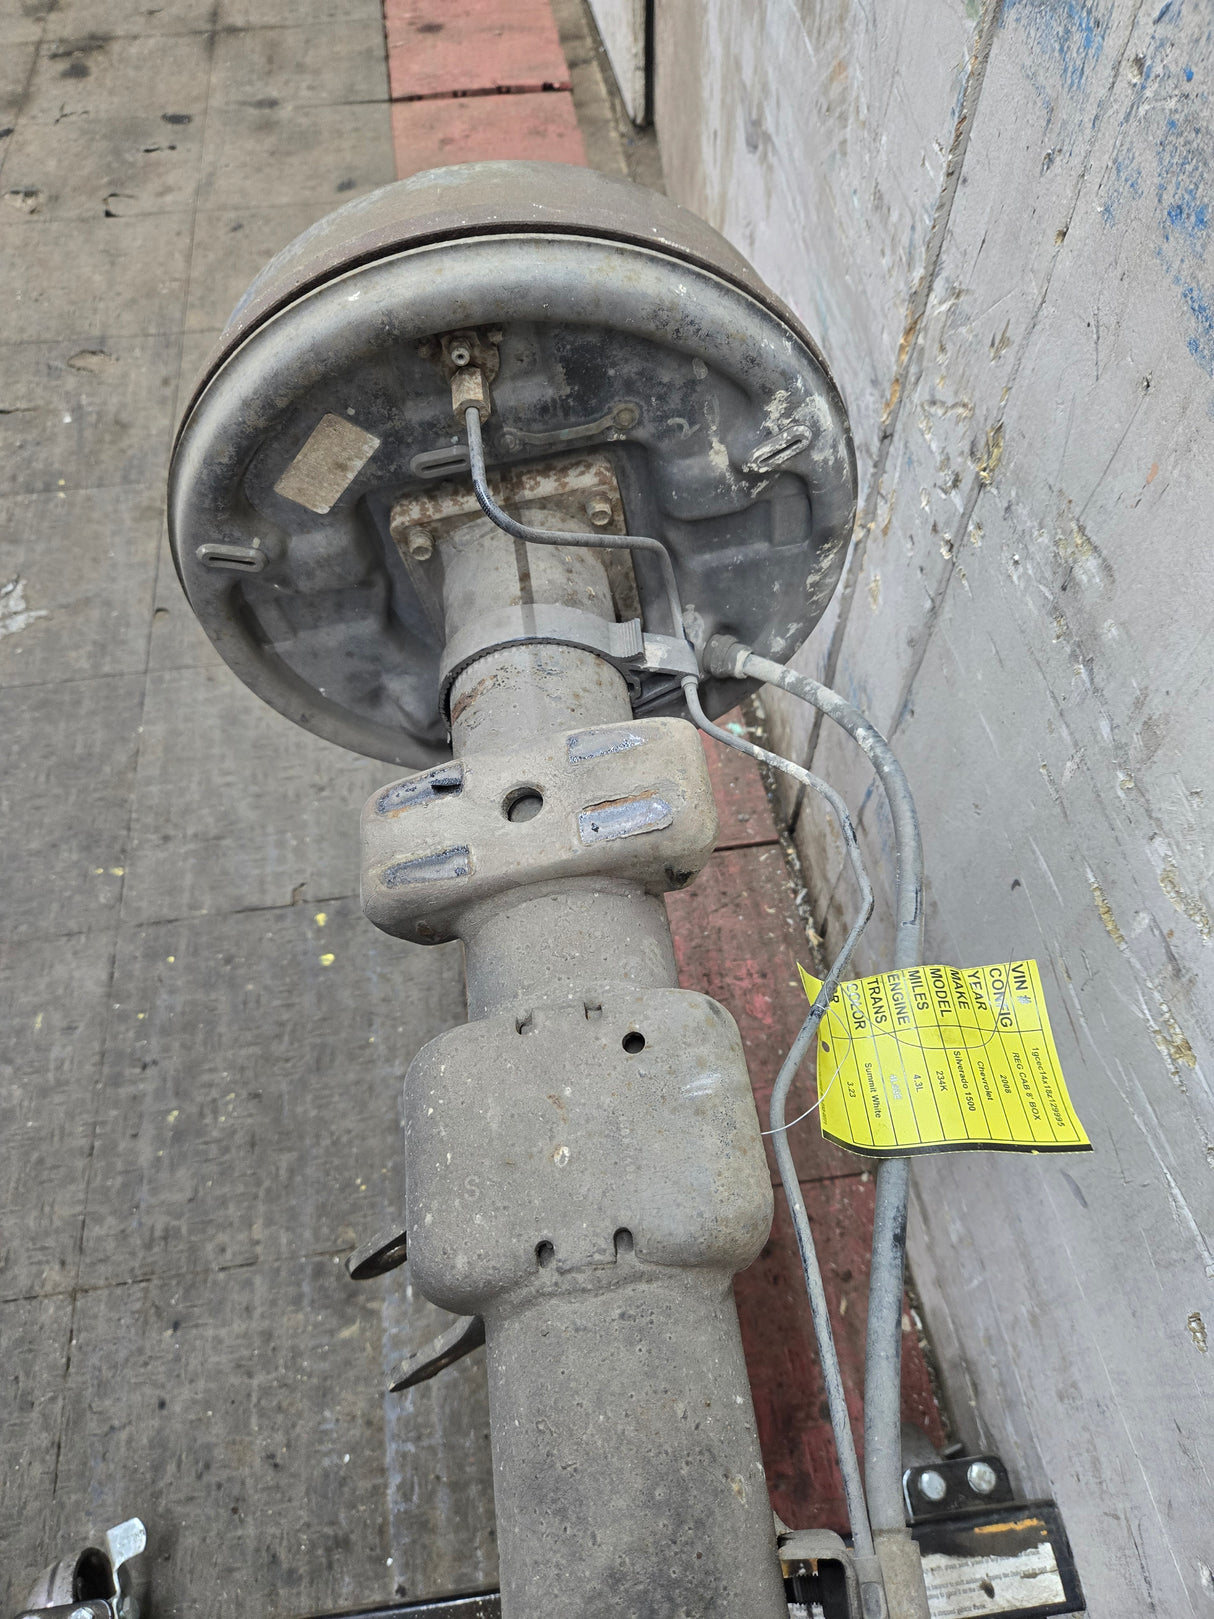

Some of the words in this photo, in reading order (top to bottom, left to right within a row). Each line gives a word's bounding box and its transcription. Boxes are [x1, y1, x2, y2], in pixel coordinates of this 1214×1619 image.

[907, 969, 929, 1010] MILES
[930, 968, 952, 1017] MODEL
[949, 969, 971, 1010] MAKE
[967, 970, 988, 1011] YEAR
[989, 967, 1013, 1028] CONFIG
[1011, 963, 1028, 991] VIN
[846, 983, 866, 1030] COLOR
[867, 977, 887, 1024] TRANS
[887, 973, 910, 1025] ENGINE
[1016, 994, 1032, 1005] #
[846, 1081, 856, 1098] 3.23
[864, 1062, 877, 1093] Summit
[871, 1095, 881, 1119] White
[913, 1074, 924, 1093] 4.3L
[936, 1070, 948, 1092] 234K
[953, 1050, 968, 1089] Silverado
[965, 1091, 976, 1112] 1500
[976, 1061, 993, 1101] Chevrolet
[1000, 1074, 1012, 1094] 2008
[1013, 1051, 1024, 1070] REG
[1019, 1072, 1031, 1090] CAB
[1029, 1101, 1041, 1121] BOX
